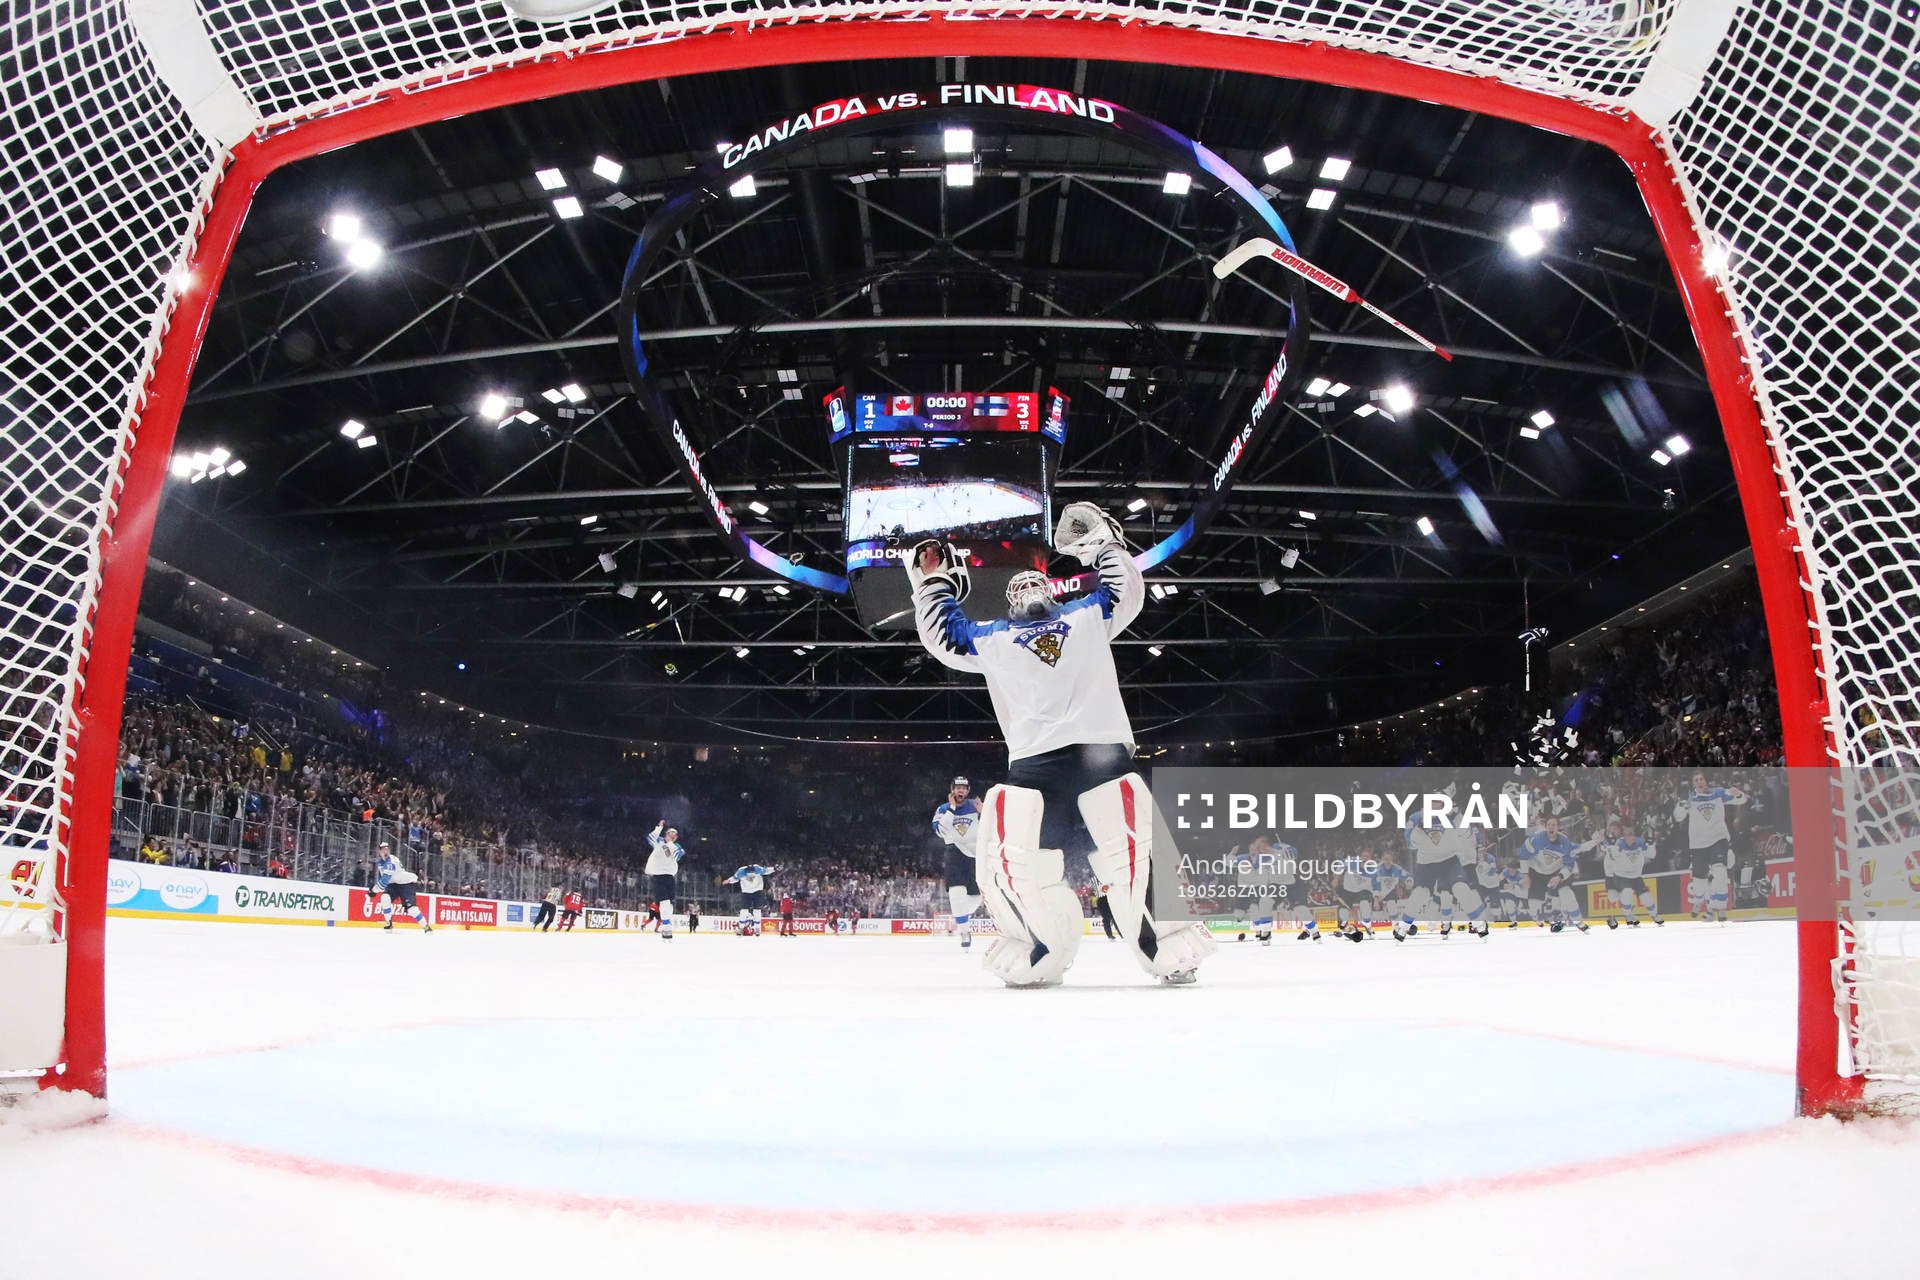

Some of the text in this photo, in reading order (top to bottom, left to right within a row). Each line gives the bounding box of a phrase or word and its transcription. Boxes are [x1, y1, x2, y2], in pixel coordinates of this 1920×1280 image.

[723, 84, 1115, 169] CANADA vs. FINLAND
[1271, 247, 1347, 295] WARRIOR
[864, 403, 876, 418] 1
[926, 397, 967, 408] 00:00
[1016, 402, 1030, 419] 3
[1213, 435, 1243, 492] CANADA
[1251, 353, 1287, 426] FINLAND
[672, 418, 700, 481] CANADA
[847, 549, 884, 562] WORLD
[1019, 624, 1065, 642] SUOMI
[253, 889, 335, 912] TRANSPETROL
[571, 894, 581, 905] 19
[440, 909, 494, 923] #BRATISLAVA
[902, 921, 946, 930] PATRON
